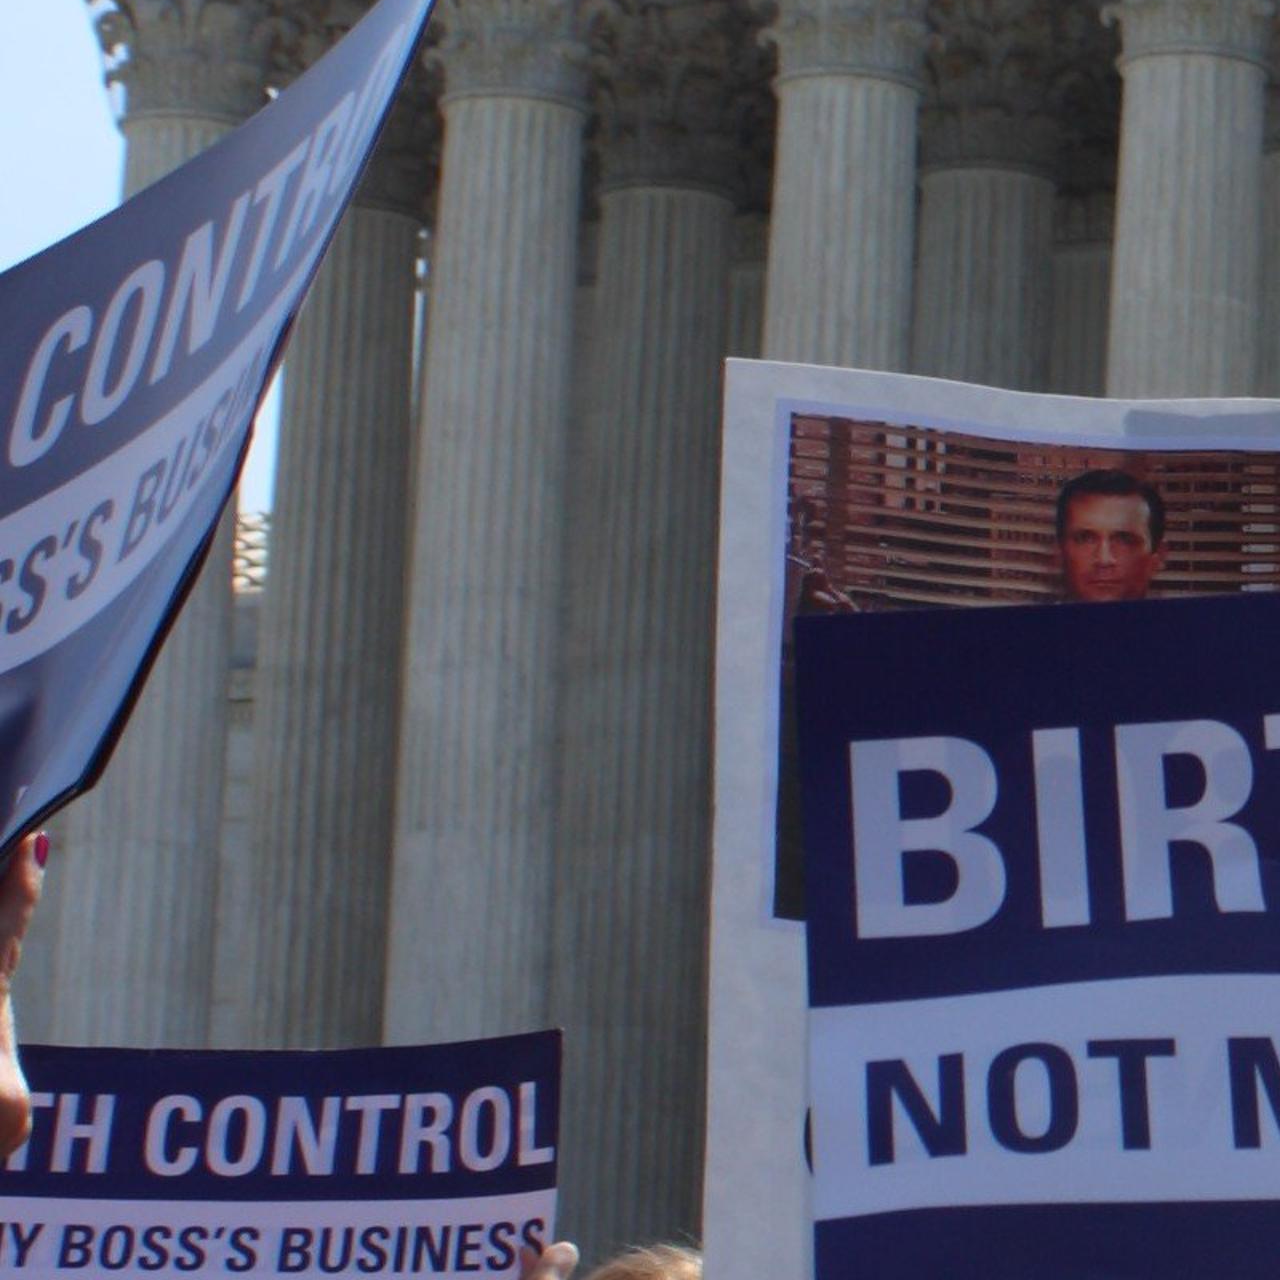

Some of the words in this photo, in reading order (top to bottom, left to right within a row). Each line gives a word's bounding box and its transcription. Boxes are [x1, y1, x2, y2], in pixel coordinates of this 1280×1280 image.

[143, 1081, 555, 1178] CONTROL
[865, 1038, 1176, 1166] NOT
[57, 1224, 260, 1273] BOSS'S
[277, 1218, 546, 1273] BUSINESS
